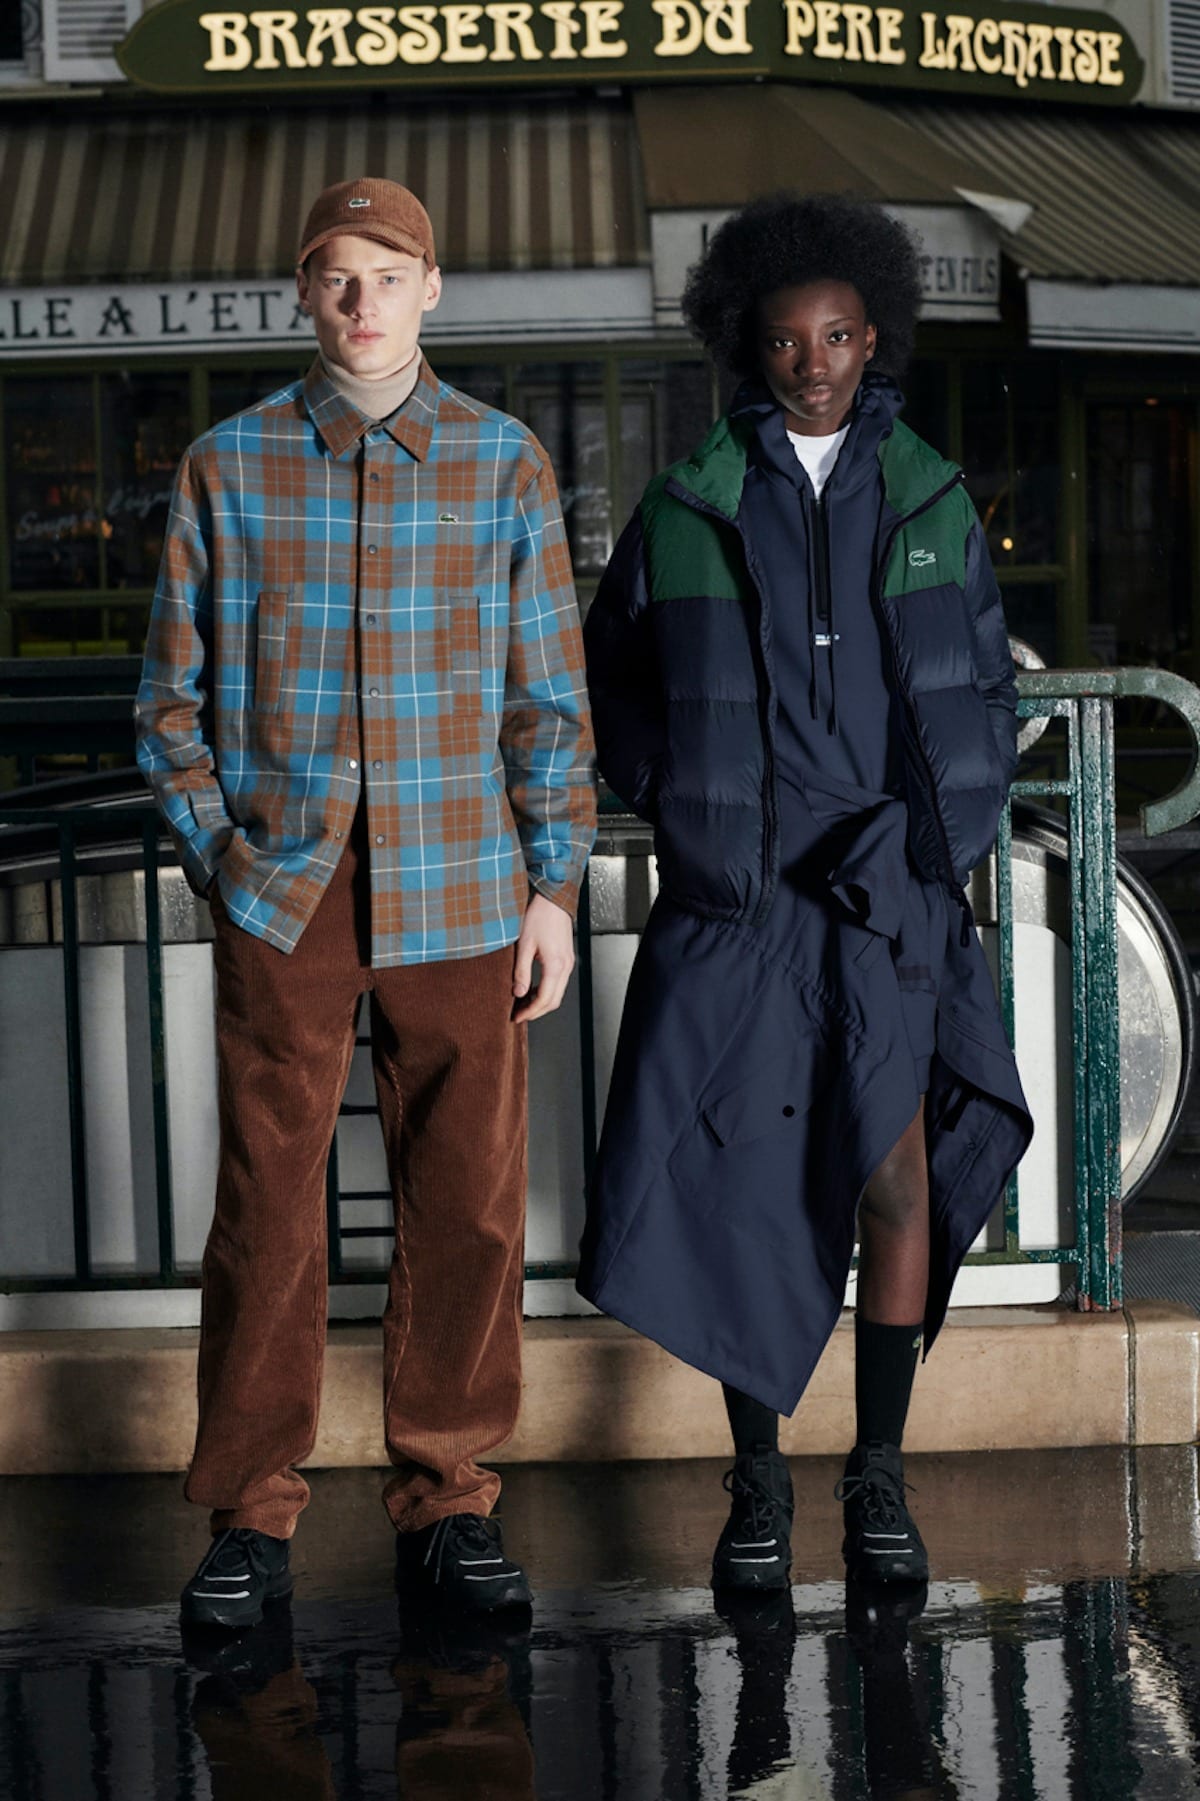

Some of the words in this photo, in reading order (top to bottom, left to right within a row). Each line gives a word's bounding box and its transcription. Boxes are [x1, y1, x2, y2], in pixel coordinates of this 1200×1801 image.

[199, 1, 627, 71] BRASSERIE
[653, 0, 752, 56] DU
[784, 0, 905, 64] PERE
[920, 12, 1124, 87] LACHAISE
[0, 298, 75, 338] LE
[98, 297, 134, 336] A
